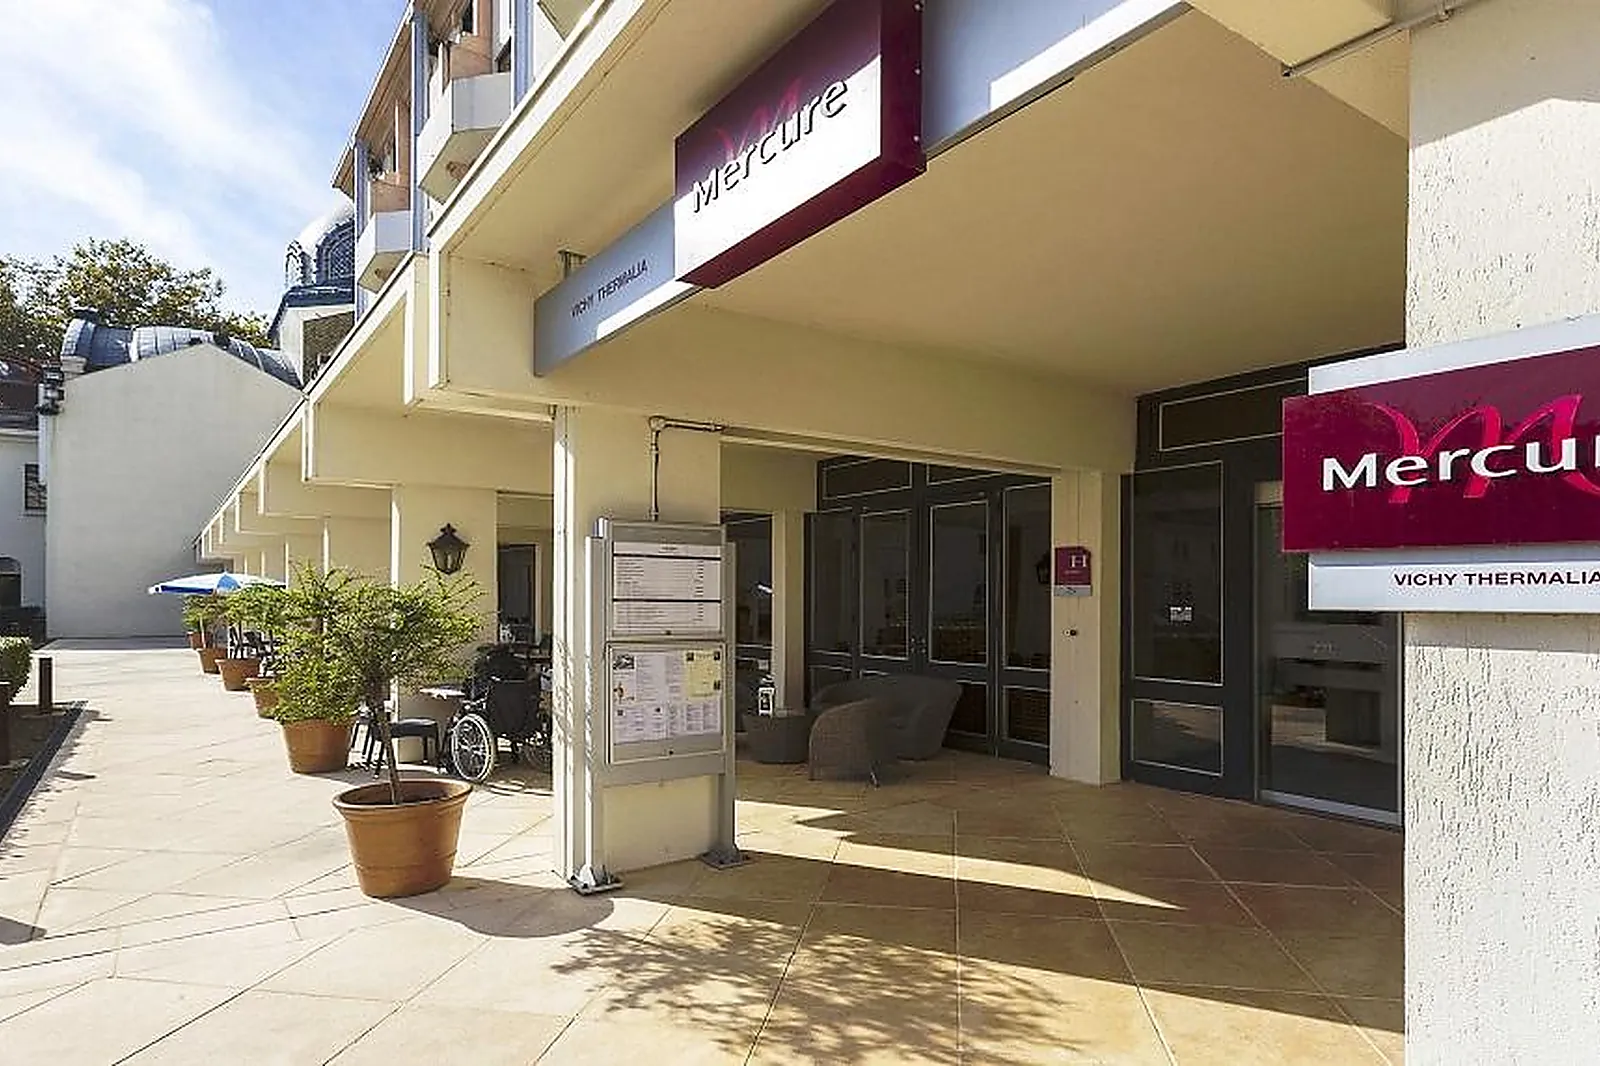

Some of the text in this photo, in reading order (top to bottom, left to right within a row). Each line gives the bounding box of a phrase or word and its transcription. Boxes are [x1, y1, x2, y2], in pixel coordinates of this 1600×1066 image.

[692, 80, 848, 213] Mercure
[571, 259, 648, 318] VICHY THERMALIA
[1322, 435, 1600, 491] Mercu
[1071, 555, 1087, 568] H
[1394, 571, 1600, 587] VICHY THERMALIA
